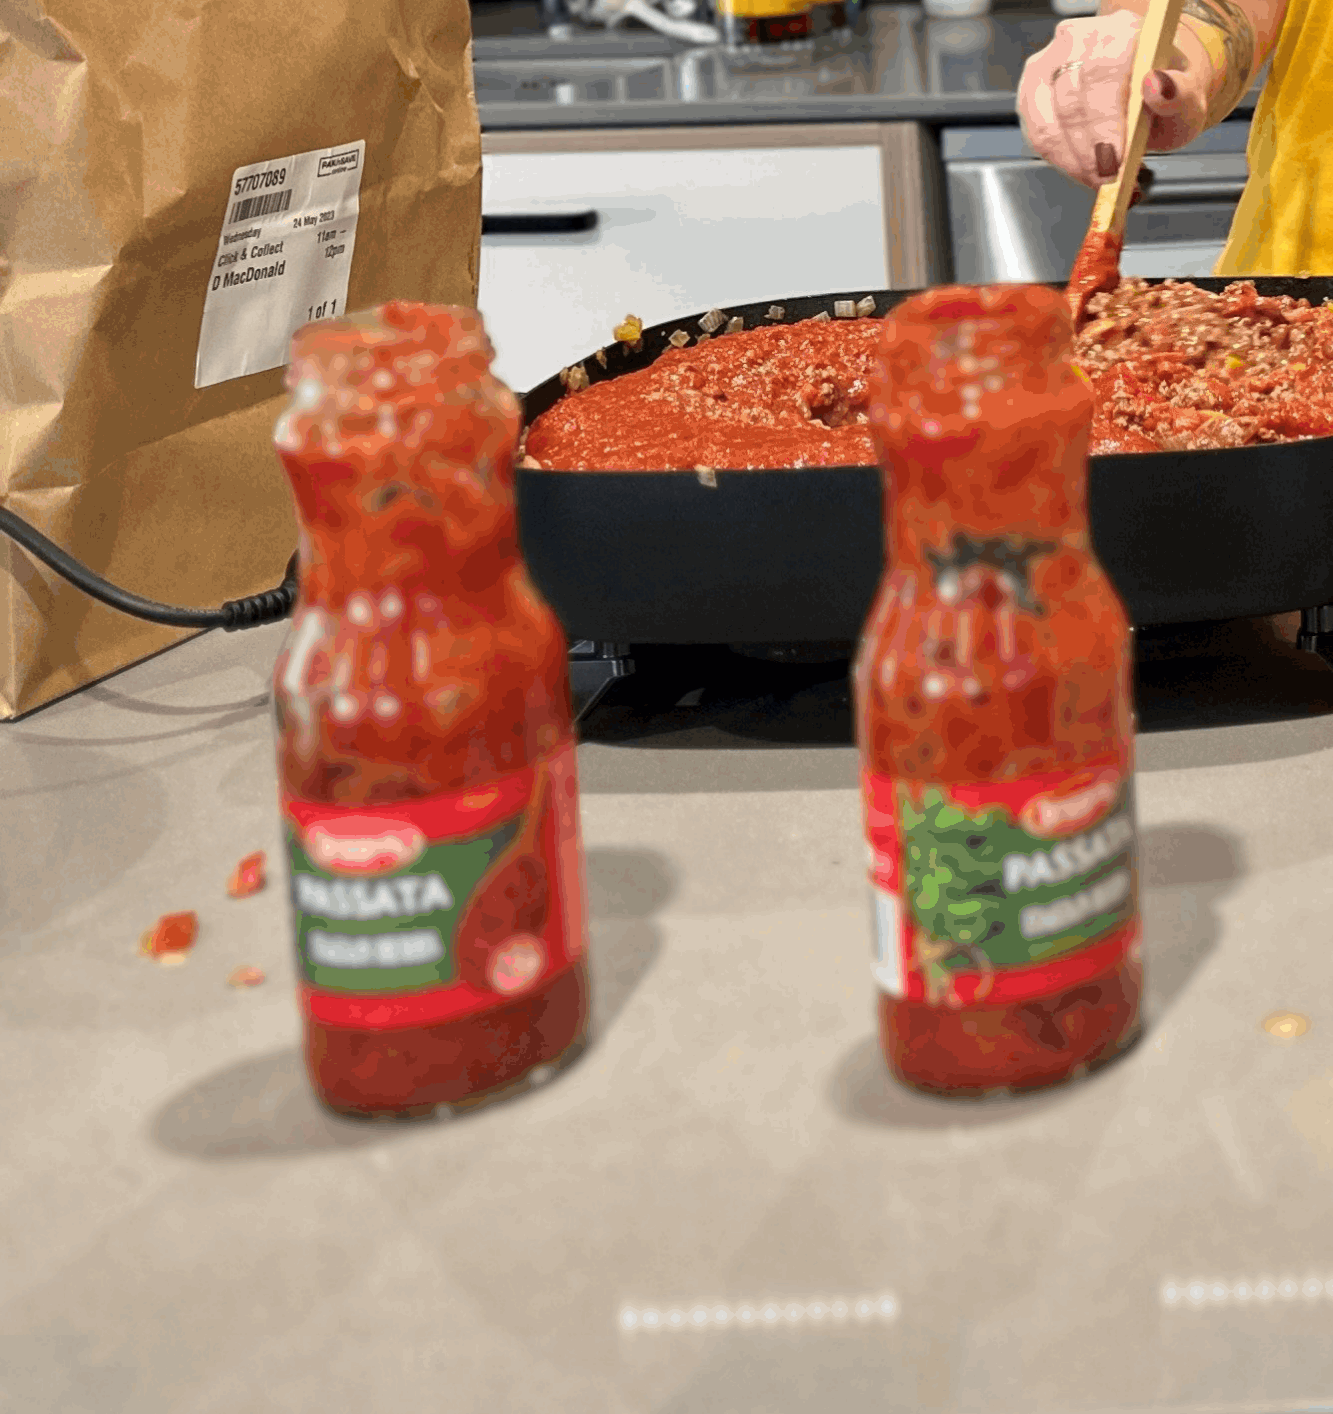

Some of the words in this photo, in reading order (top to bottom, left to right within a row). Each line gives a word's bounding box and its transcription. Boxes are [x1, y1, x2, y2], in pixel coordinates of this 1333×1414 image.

[234, 168, 287, 195] 57707089
[293, 218, 302, 228] 24
[303, 215, 317, 226] May
[218, 251, 238, 267] Click
[240, 248, 247, 261] &
[251, 241, 284, 259] Collect
[212, 275, 221, 291] D
[223, 260, 286, 288] MacDonald
[308, 306, 313, 321] 1
[315, 301, 328, 319] of
[331, 299, 337, 314] 1
